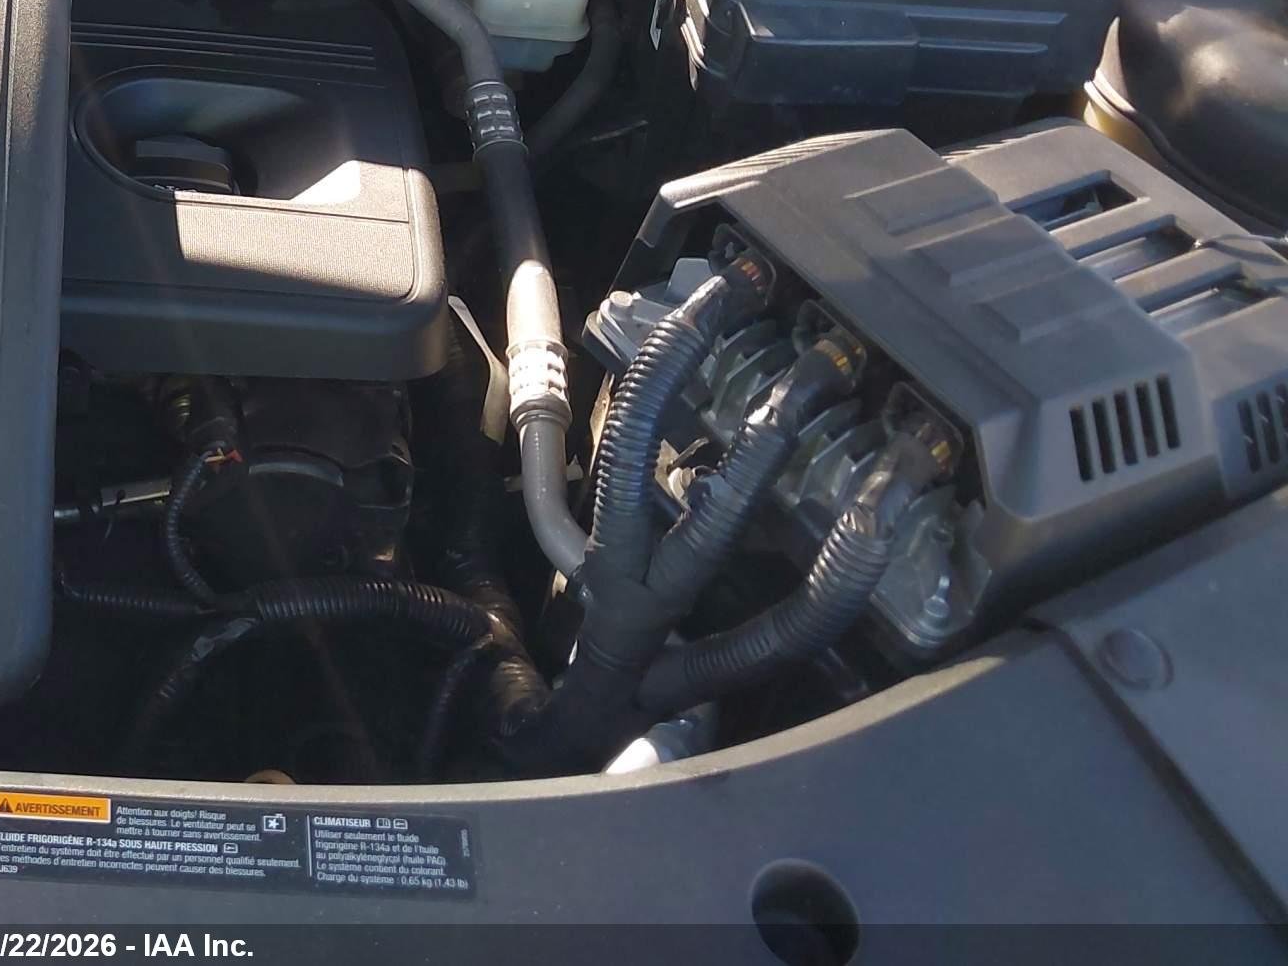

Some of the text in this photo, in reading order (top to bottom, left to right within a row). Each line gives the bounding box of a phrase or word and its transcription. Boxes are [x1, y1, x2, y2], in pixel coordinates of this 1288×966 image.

[15, 802, 101, 817] AVERTISSEMENT
[116, 806, 152, 816] Attention
[154, 809, 168, 817] aux
[199, 811, 226, 821] Risque
[116, 817, 126, 825] de
[171, 819, 180, 828] Le
[183, 820, 224, 830] ventilateur
[226, 822, 244, 831] peut
[313, 816, 372, 828] CLIMATISEUR
[116, 827, 142, 835] mettre
[152, 828, 180, 837] tourner
[203, 831, 262, 842] avertissement.
[314, 829, 420, 843] Utiliser seulement le fluide
[86, 837, 117, 848] R-134a
[119, 839, 143, 849] SOUS
[144, 840, 172, 851] HAUTE
[175, 842, 218, 853] PRESSION
[360, 842, 390, 852] R-134a
[392, 844, 400, 852] et
[402, 844, 412, 853] de
[39, 845, 49, 854] du
[51, 847, 84, 857] système
[86, 848, 102, 857] doit
[104, 849, 120, 858] être
[121, 850, 154, 860] effectué
[156, 853, 170, 862] par
[172, 853, 182, 861] un
[184, 854, 223, 865] personnel
[225, 856, 255, 866] qualifié
[257, 858, 302, 868] seulement.
[315, 852, 326, 860] au
[402, 855, 425, 865] (huile
[0, 864, 18, 874] J639
[12, 855, 51, 865] méthodes
[53, 857, 97, 867] d'entretien
[99, 860, 143, 870] incorrectes
[145, 863, 177, 873] peuvent
[179, 865, 206, 874] causer
[208, 866, 224, 875] des
[225, 866, 267, 877] blessures.
[316, 862, 327, 870] Le
[364, 864, 397, 874] contient
[398, 865, 409, 874] du
[317, 873, 346, 883] Charge
[347, 873, 358, 882] du
[421, 879, 433, 889] kg
